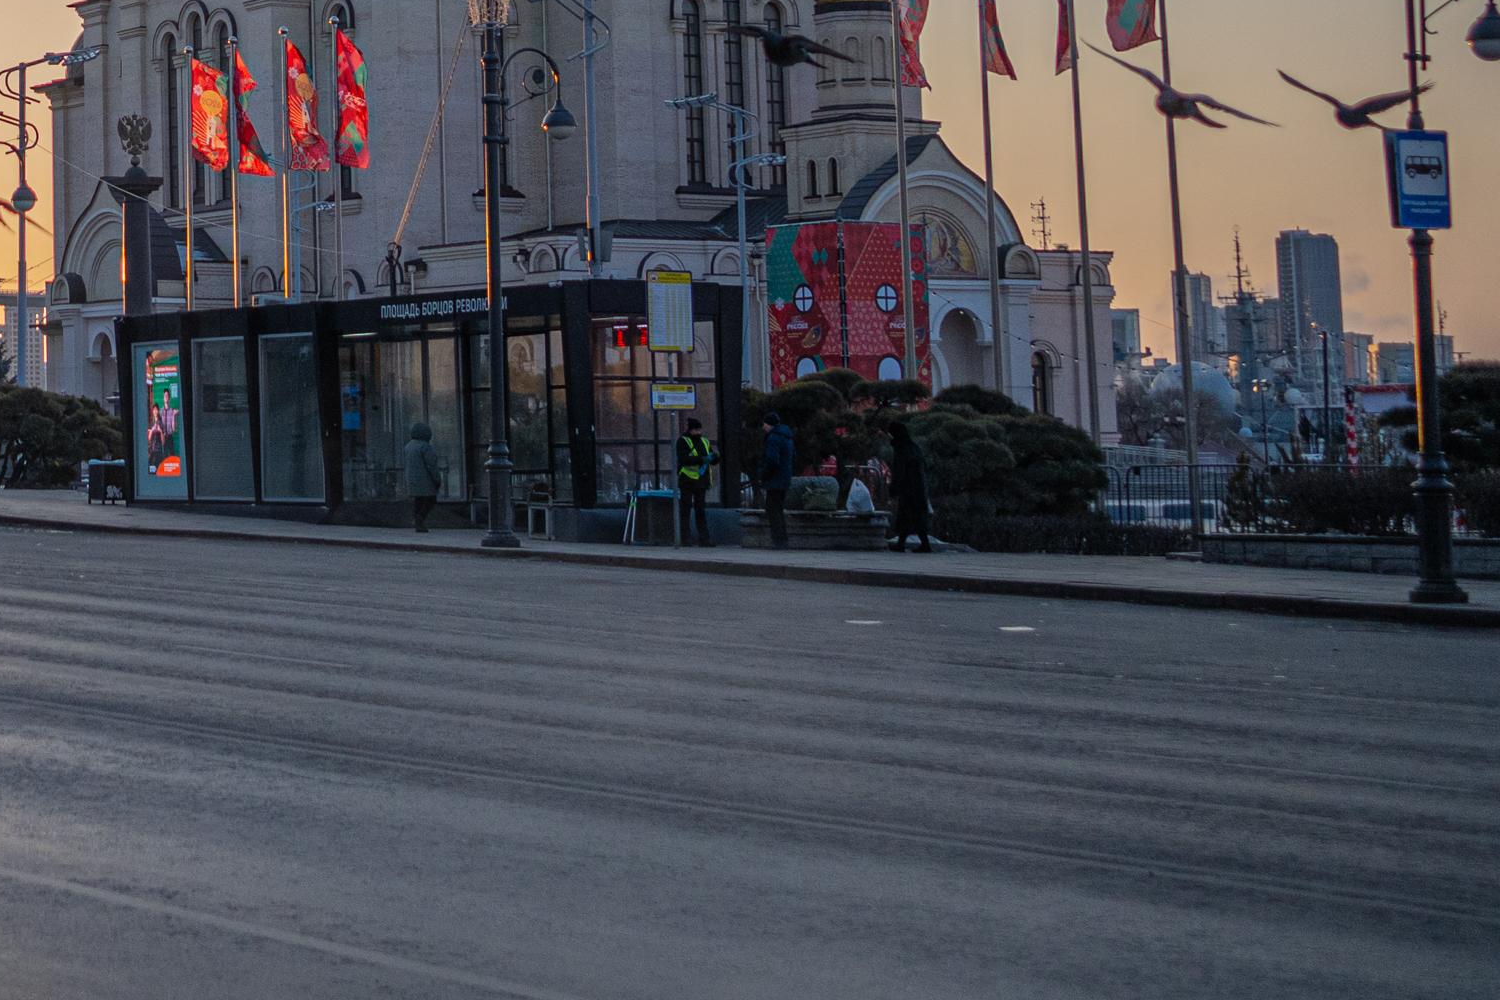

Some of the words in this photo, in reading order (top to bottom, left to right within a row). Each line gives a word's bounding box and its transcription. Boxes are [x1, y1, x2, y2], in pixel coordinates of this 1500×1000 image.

[380, 303, 420, 319] ПЛОЩАДЬ
[422, 300, 454, 316] БОРЦОВ
[456, 296, 507, 312] РЕВОЛЮИ
